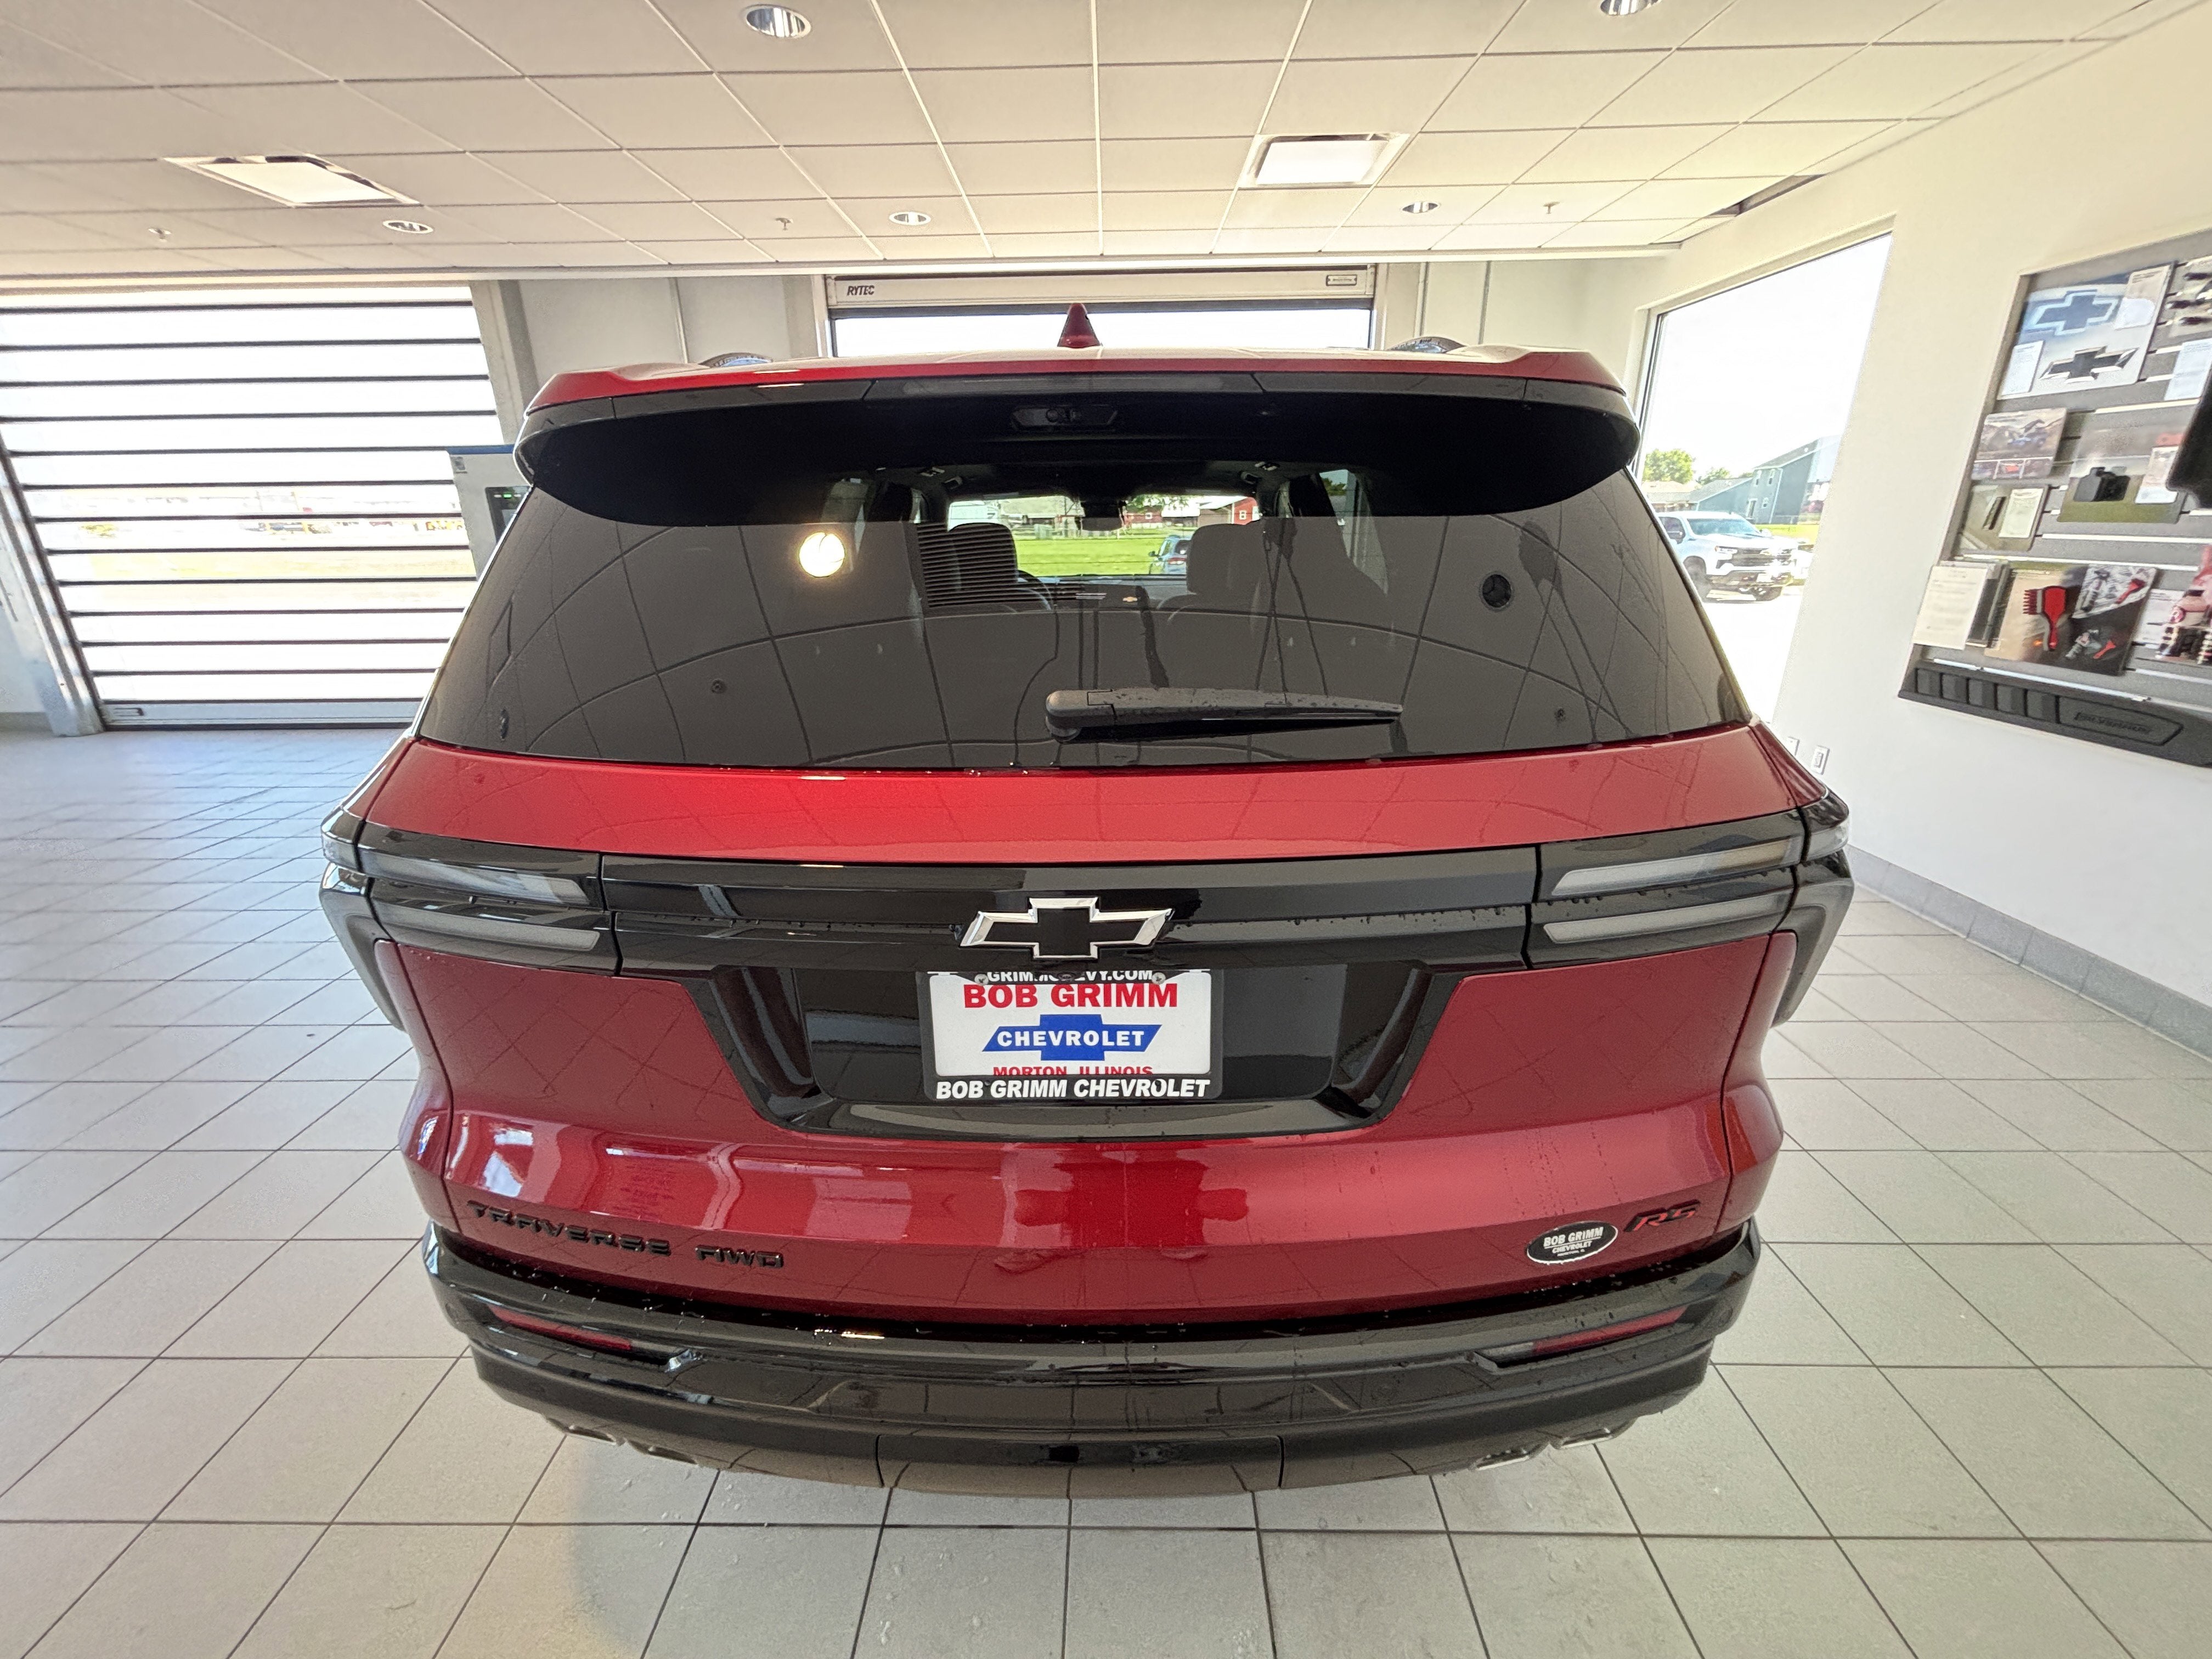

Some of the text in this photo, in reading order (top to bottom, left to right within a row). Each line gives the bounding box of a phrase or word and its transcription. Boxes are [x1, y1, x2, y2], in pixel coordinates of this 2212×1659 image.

[847, 285, 875, 296] RYTEC
[988, 970, 1152, 981] GRIMVY.COM
[964, 983, 1178, 1008] BOB GRIMM
[997, 1030, 1145, 1047] CHEVROLET
[993, 1066, 1153, 1075] MORTON ILLINOIS
[936, 1079, 1210, 1099] BOB GRIMM CHEVROLET
[1623, 1199, 1701, 1232] RS
[466, 1200, 784, 1268] TRAVERSE AWD
[1543, 1226, 1604, 1248] BOB GRIMM
[1551, 1240, 1593, 1254] CHEVROLET
